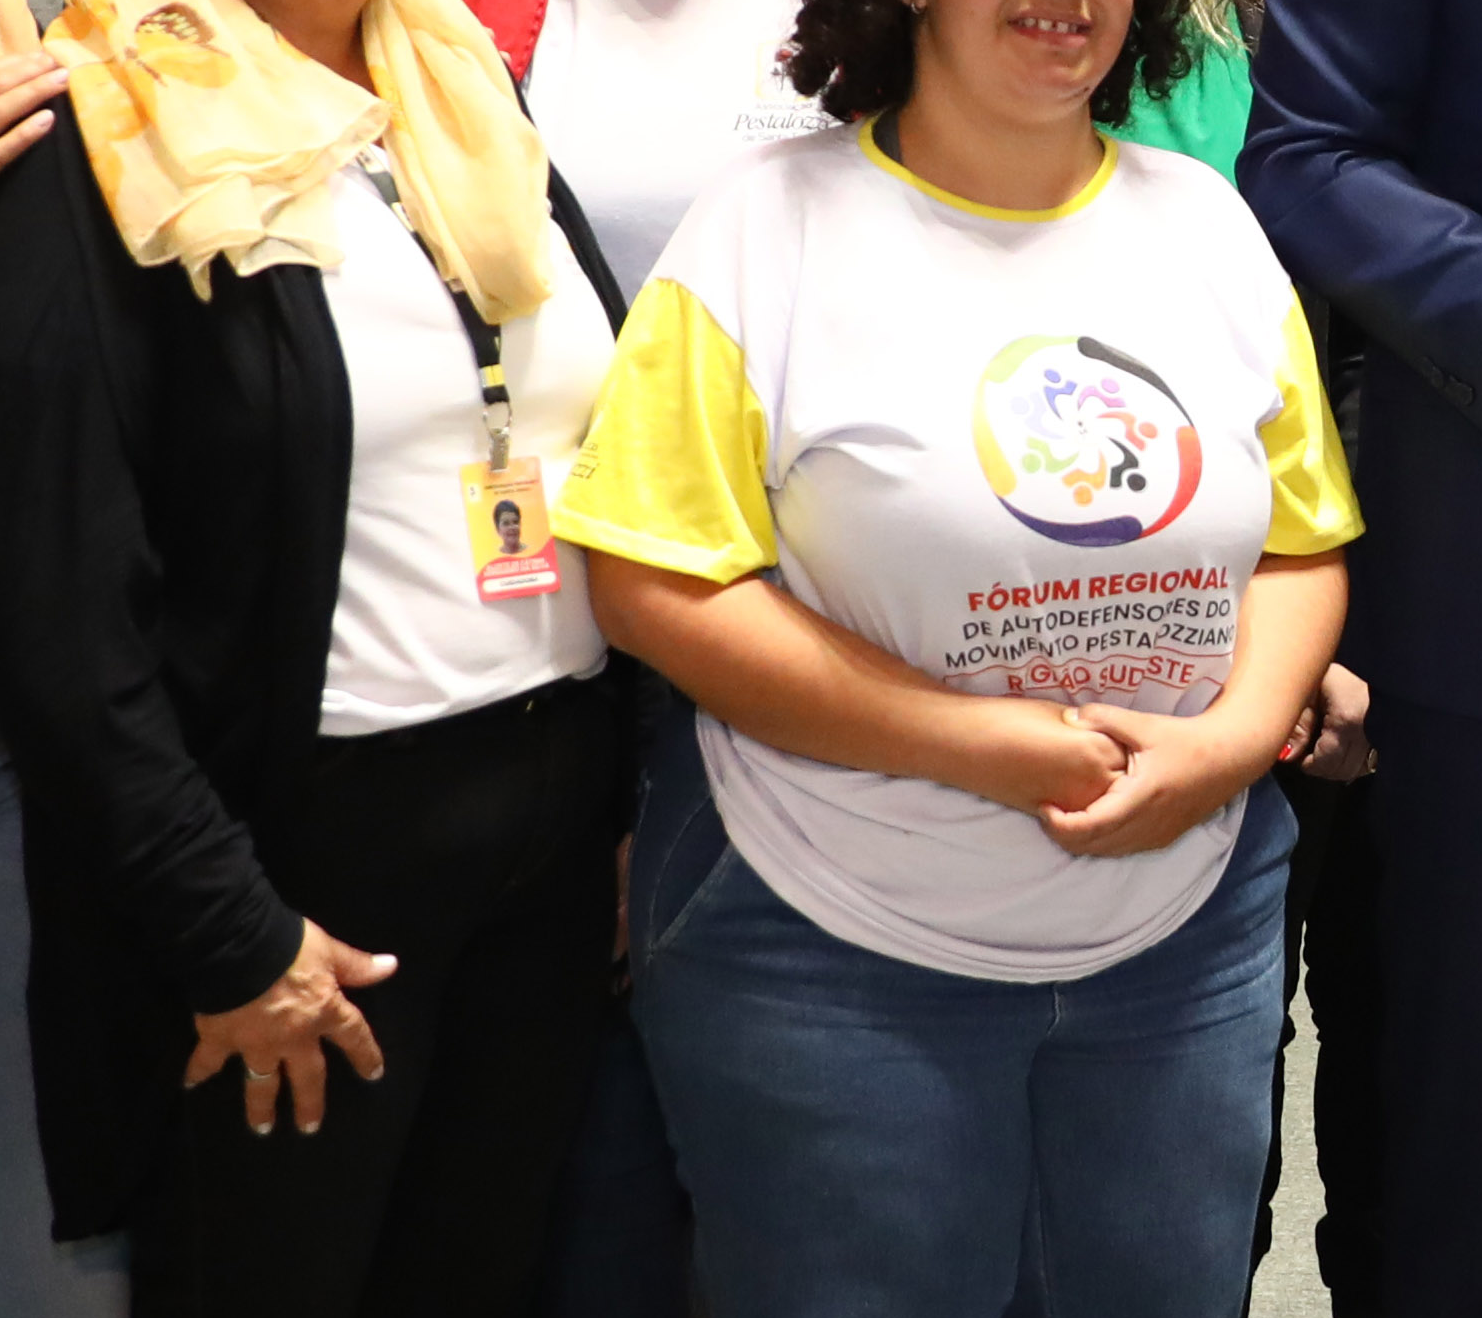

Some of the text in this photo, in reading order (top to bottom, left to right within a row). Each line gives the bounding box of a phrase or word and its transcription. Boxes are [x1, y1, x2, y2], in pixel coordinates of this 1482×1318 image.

[968, 566, 1228, 611] FÓRUM REGIONAL
[963, 620, 993, 640] DE
[1205, 599, 1231, 619] DO
[945, 635, 1079, 668] MOVIMENTO
[1008, 655, 1195, 692] RGIÃO SUDSTE
